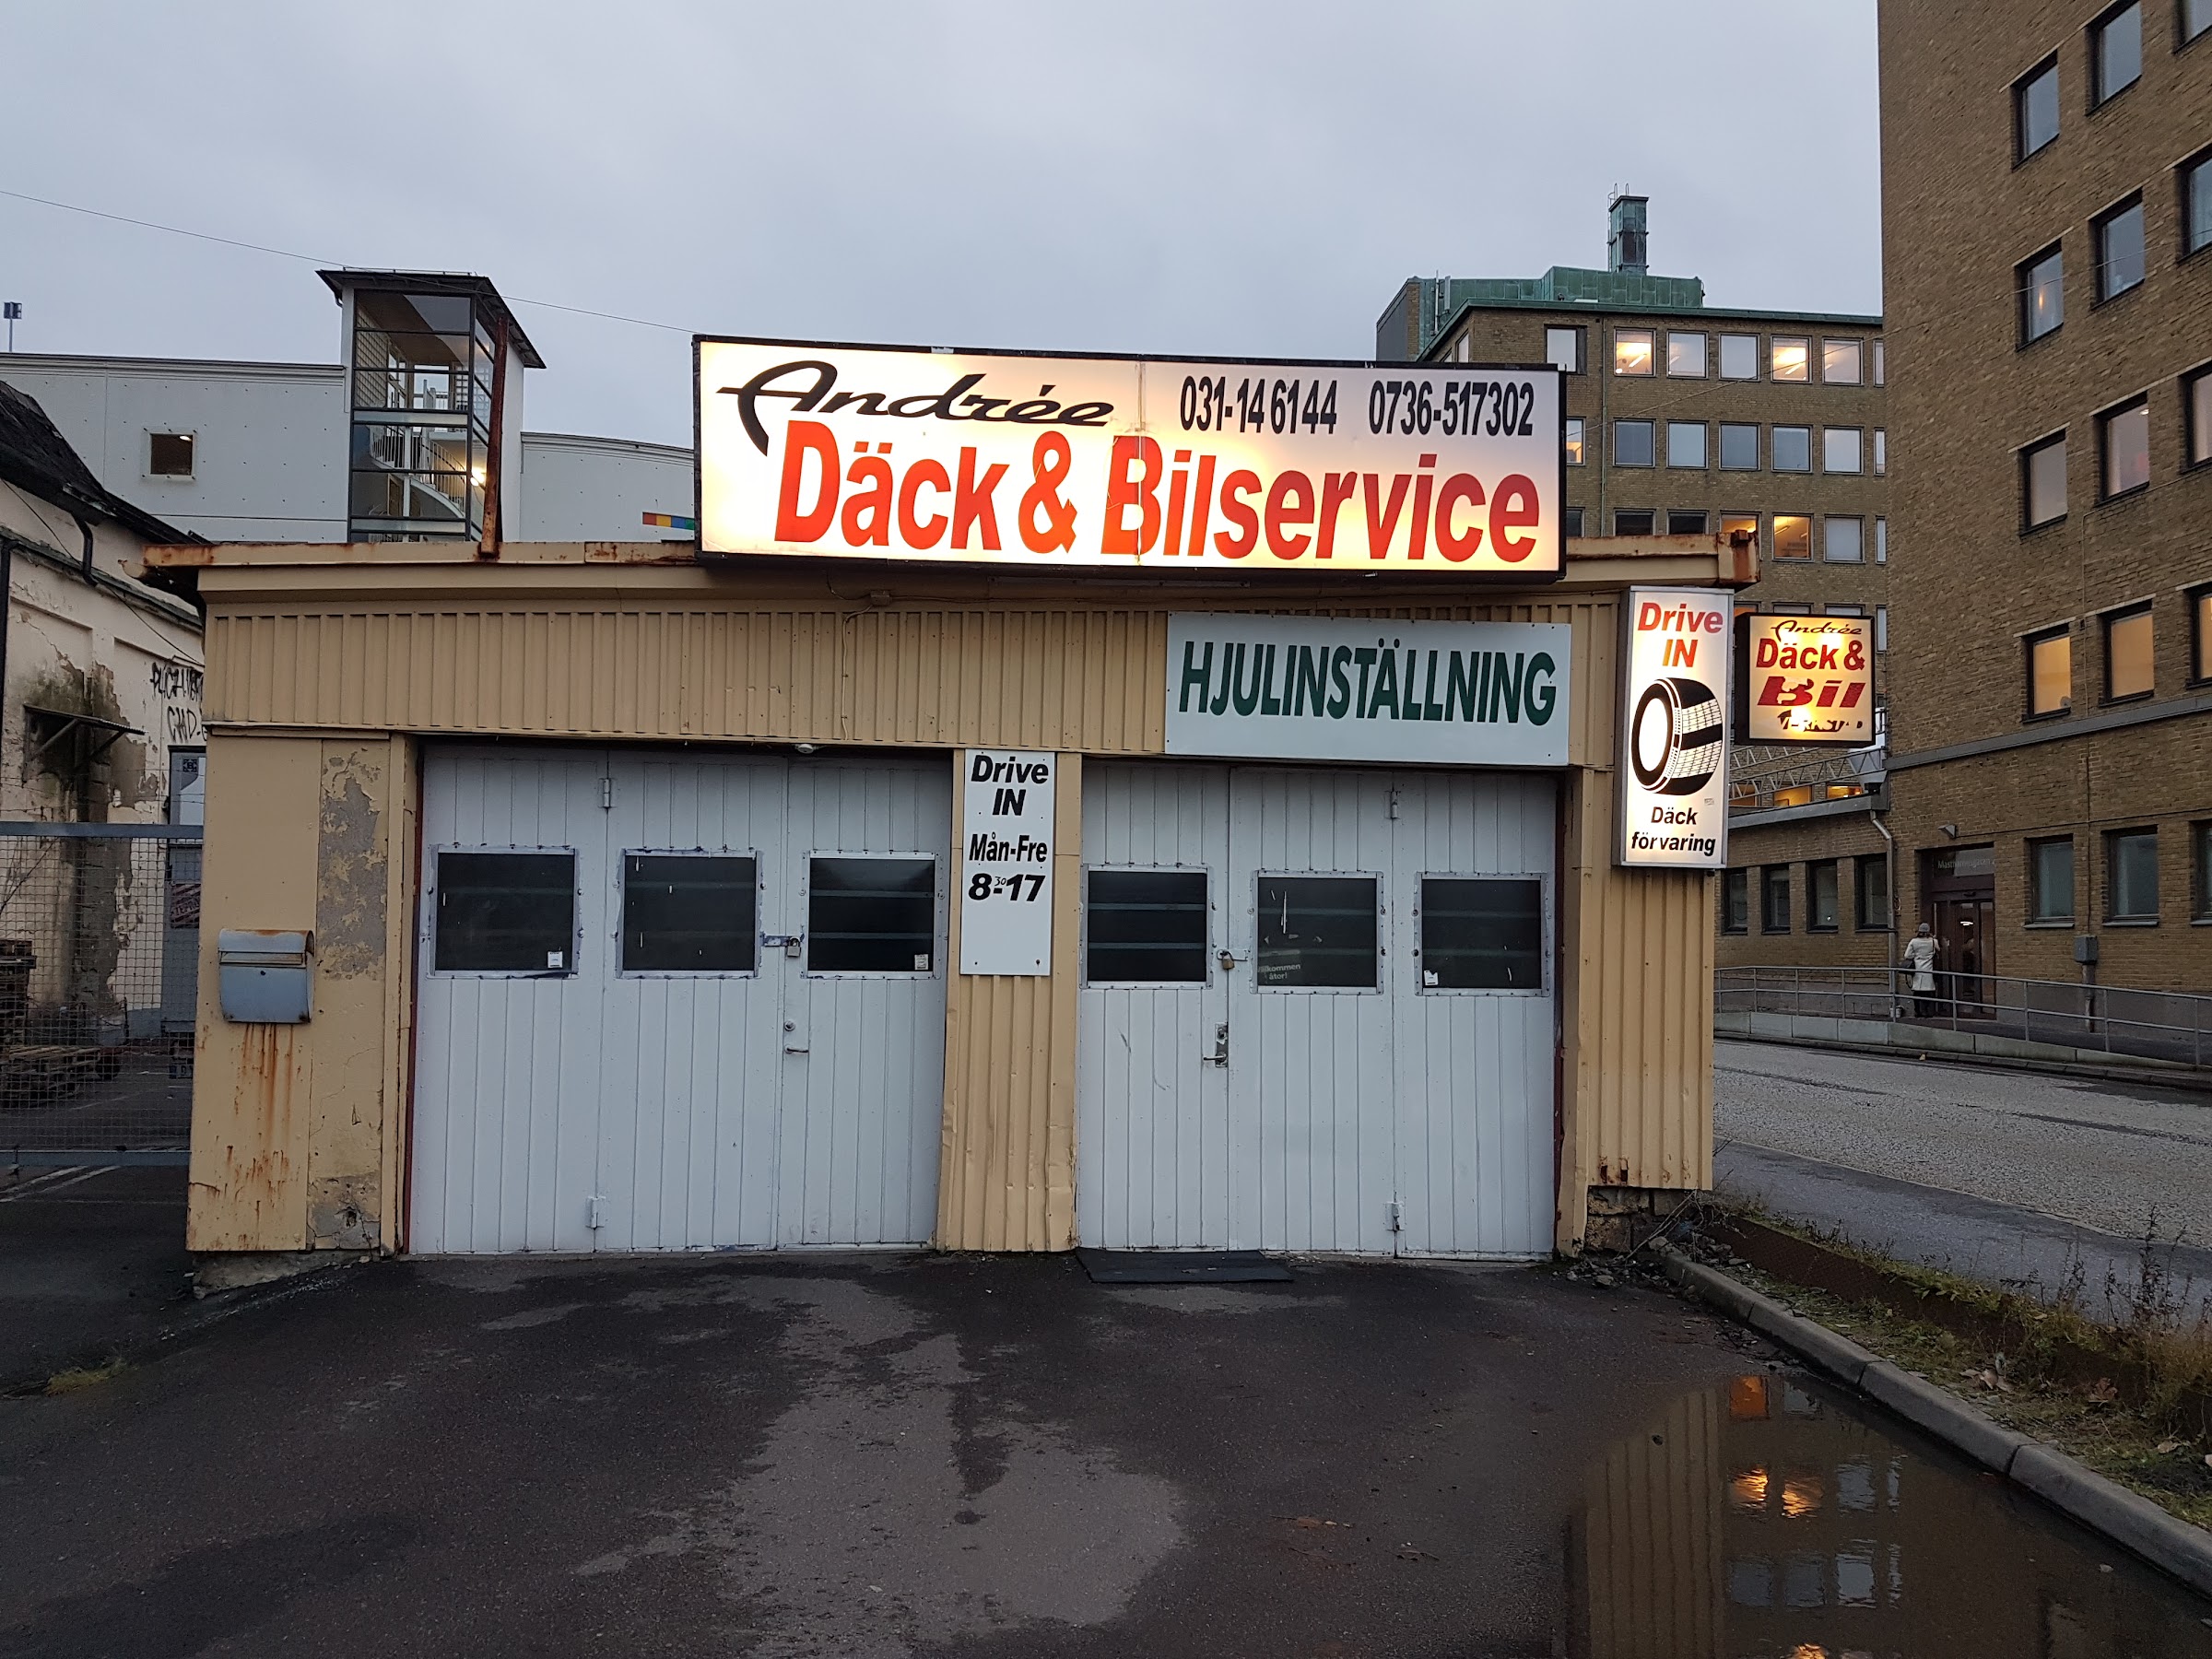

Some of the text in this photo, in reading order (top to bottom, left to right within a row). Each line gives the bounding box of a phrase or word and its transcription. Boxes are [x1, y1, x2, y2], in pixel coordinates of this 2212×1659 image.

[716, 359, 1113, 456] Andrée
[1369, 380, 1535, 436] 0736-517302
[774, 419, 1540, 562] Däck & Bilservice
[1637, 602, 1724, 633] Drive
[1662, 639, 1699, 667] IN
[1756, 638, 1865, 671] Däck &
[1179, 638, 1557, 726] HJULINSTÄLLNING
[1757, 676, 1866, 708] Bil
[971, 754, 1049, 784] Drive
[992, 788, 1026, 816] IN
[1651, 806, 1699, 825] Däck
[969, 831, 1047, 863] Mån-Fre
